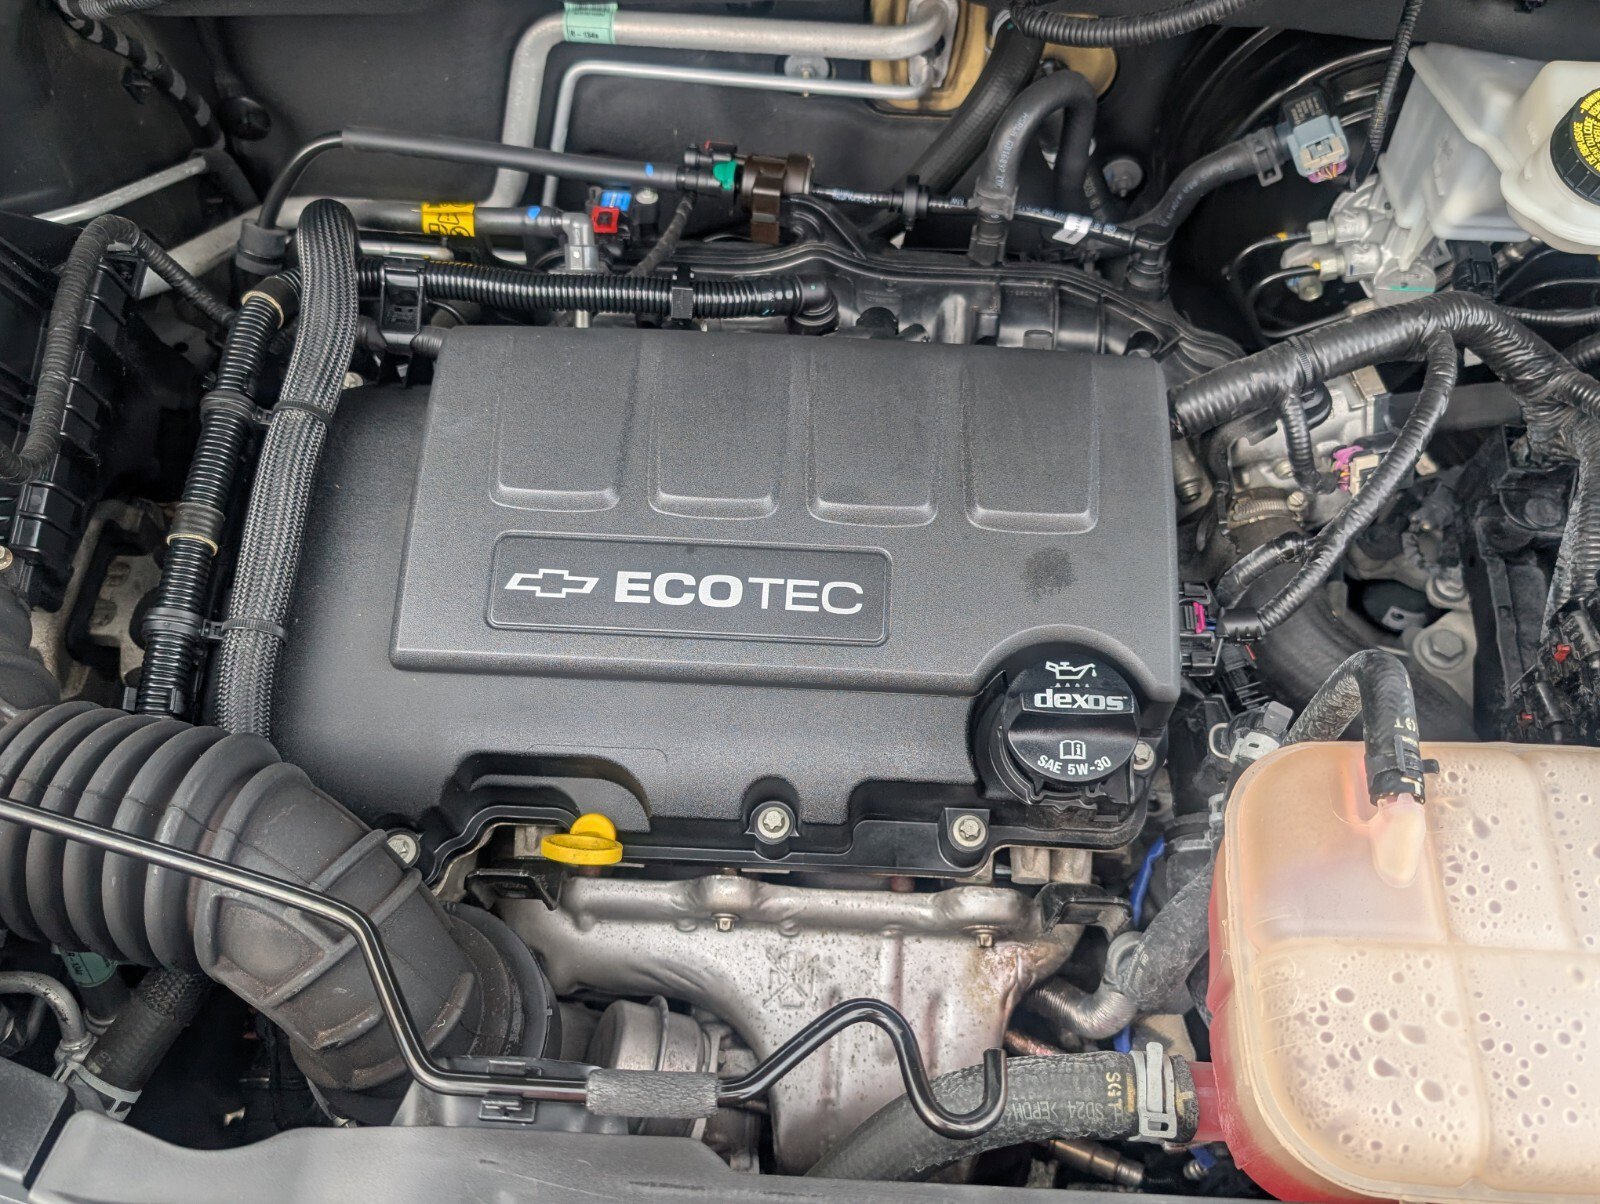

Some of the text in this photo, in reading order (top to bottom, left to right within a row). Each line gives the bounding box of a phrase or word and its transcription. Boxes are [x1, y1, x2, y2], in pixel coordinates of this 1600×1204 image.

[614, 570, 865, 616] ECOTEC
[1034, 689, 1124, 710] dexos
[1037, 754, 1112, 776] SAE 5W-30
